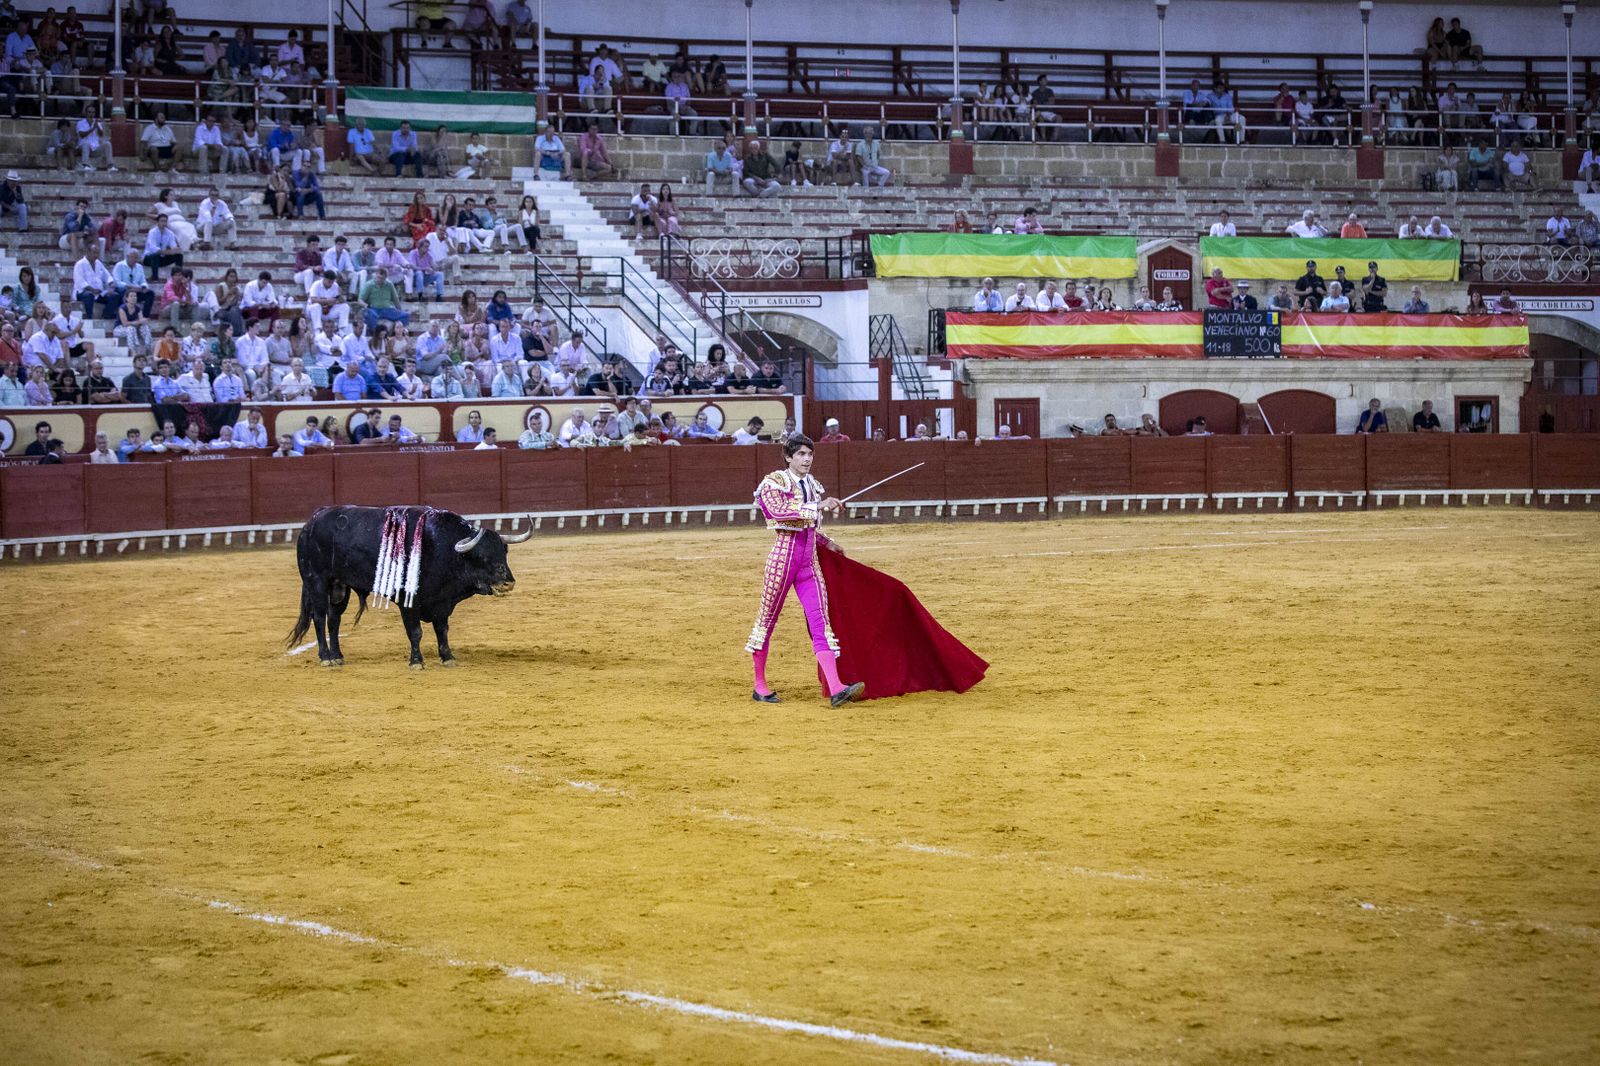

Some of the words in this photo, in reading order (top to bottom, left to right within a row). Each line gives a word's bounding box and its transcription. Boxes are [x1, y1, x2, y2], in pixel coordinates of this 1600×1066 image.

[1156, 271, 1188, 279] TORILES
[748, 298, 759, 306] DE
[766, 297, 811, 305] CABALLOS
[1531, 301, 1587, 309] CUADRILLAS
[1208, 313, 1263, 324] MONTALVO
[1204, 325, 1258, 336] VENECIANO
[1245, 338, 1271, 353] 500
